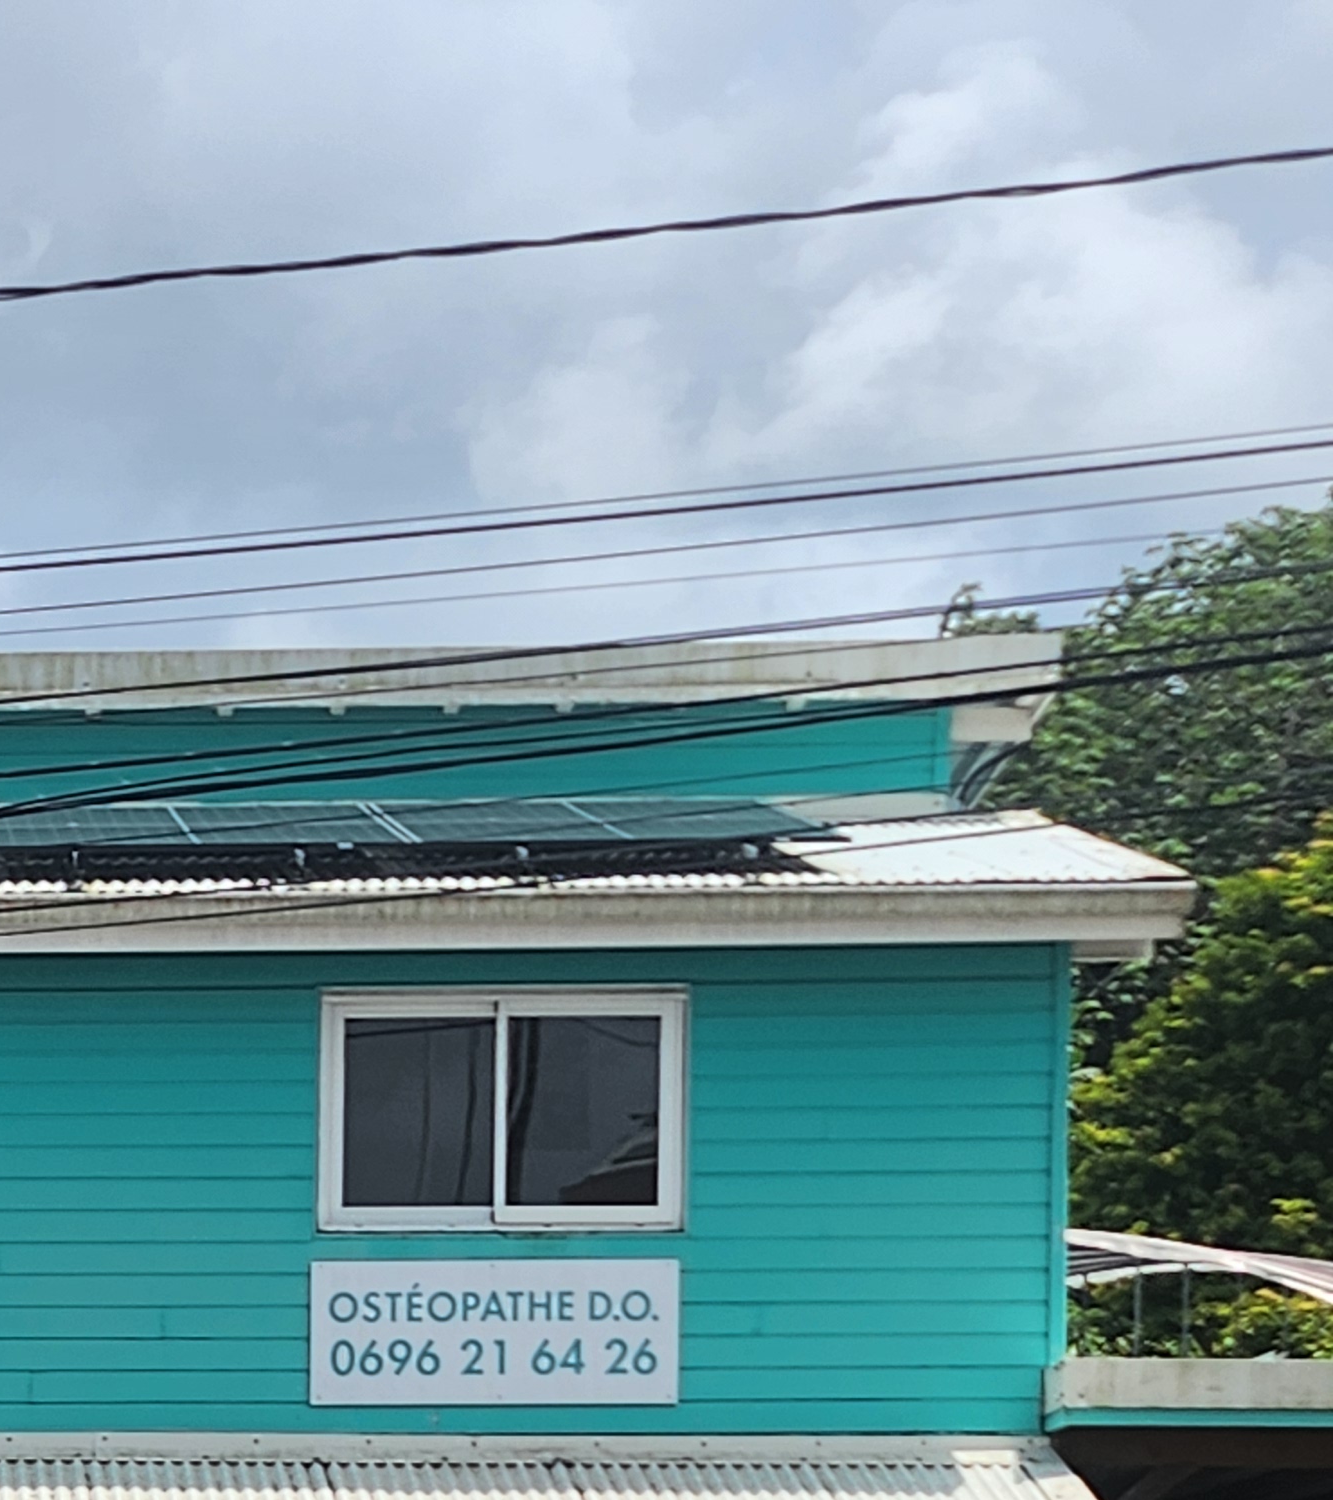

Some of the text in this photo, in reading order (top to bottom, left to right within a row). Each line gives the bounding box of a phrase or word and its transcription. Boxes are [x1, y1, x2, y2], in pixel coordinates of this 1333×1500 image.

[328, 1283, 660, 1323] OSTÉOPATHE D.O.
[330, 1338, 658, 1376] 0696 21 64 26
